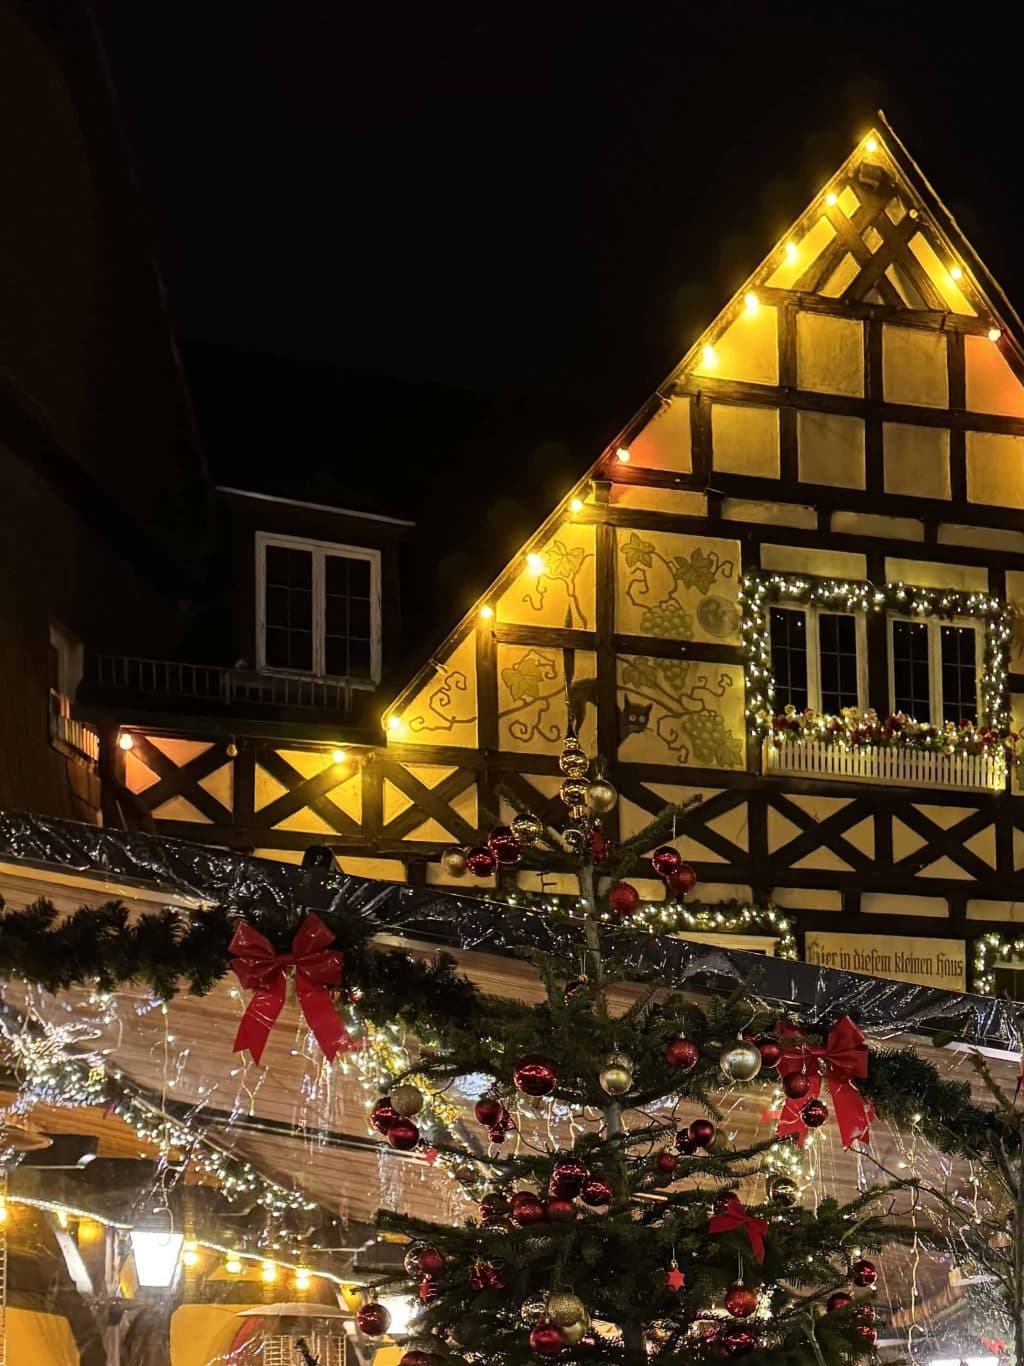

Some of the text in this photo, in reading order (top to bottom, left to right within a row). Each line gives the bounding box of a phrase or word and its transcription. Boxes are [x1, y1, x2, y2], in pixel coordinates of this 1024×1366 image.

[840, 950, 852, 970] in
[894, 951, 933, 977] kleinen
[936, 952, 964, 979] Haus
